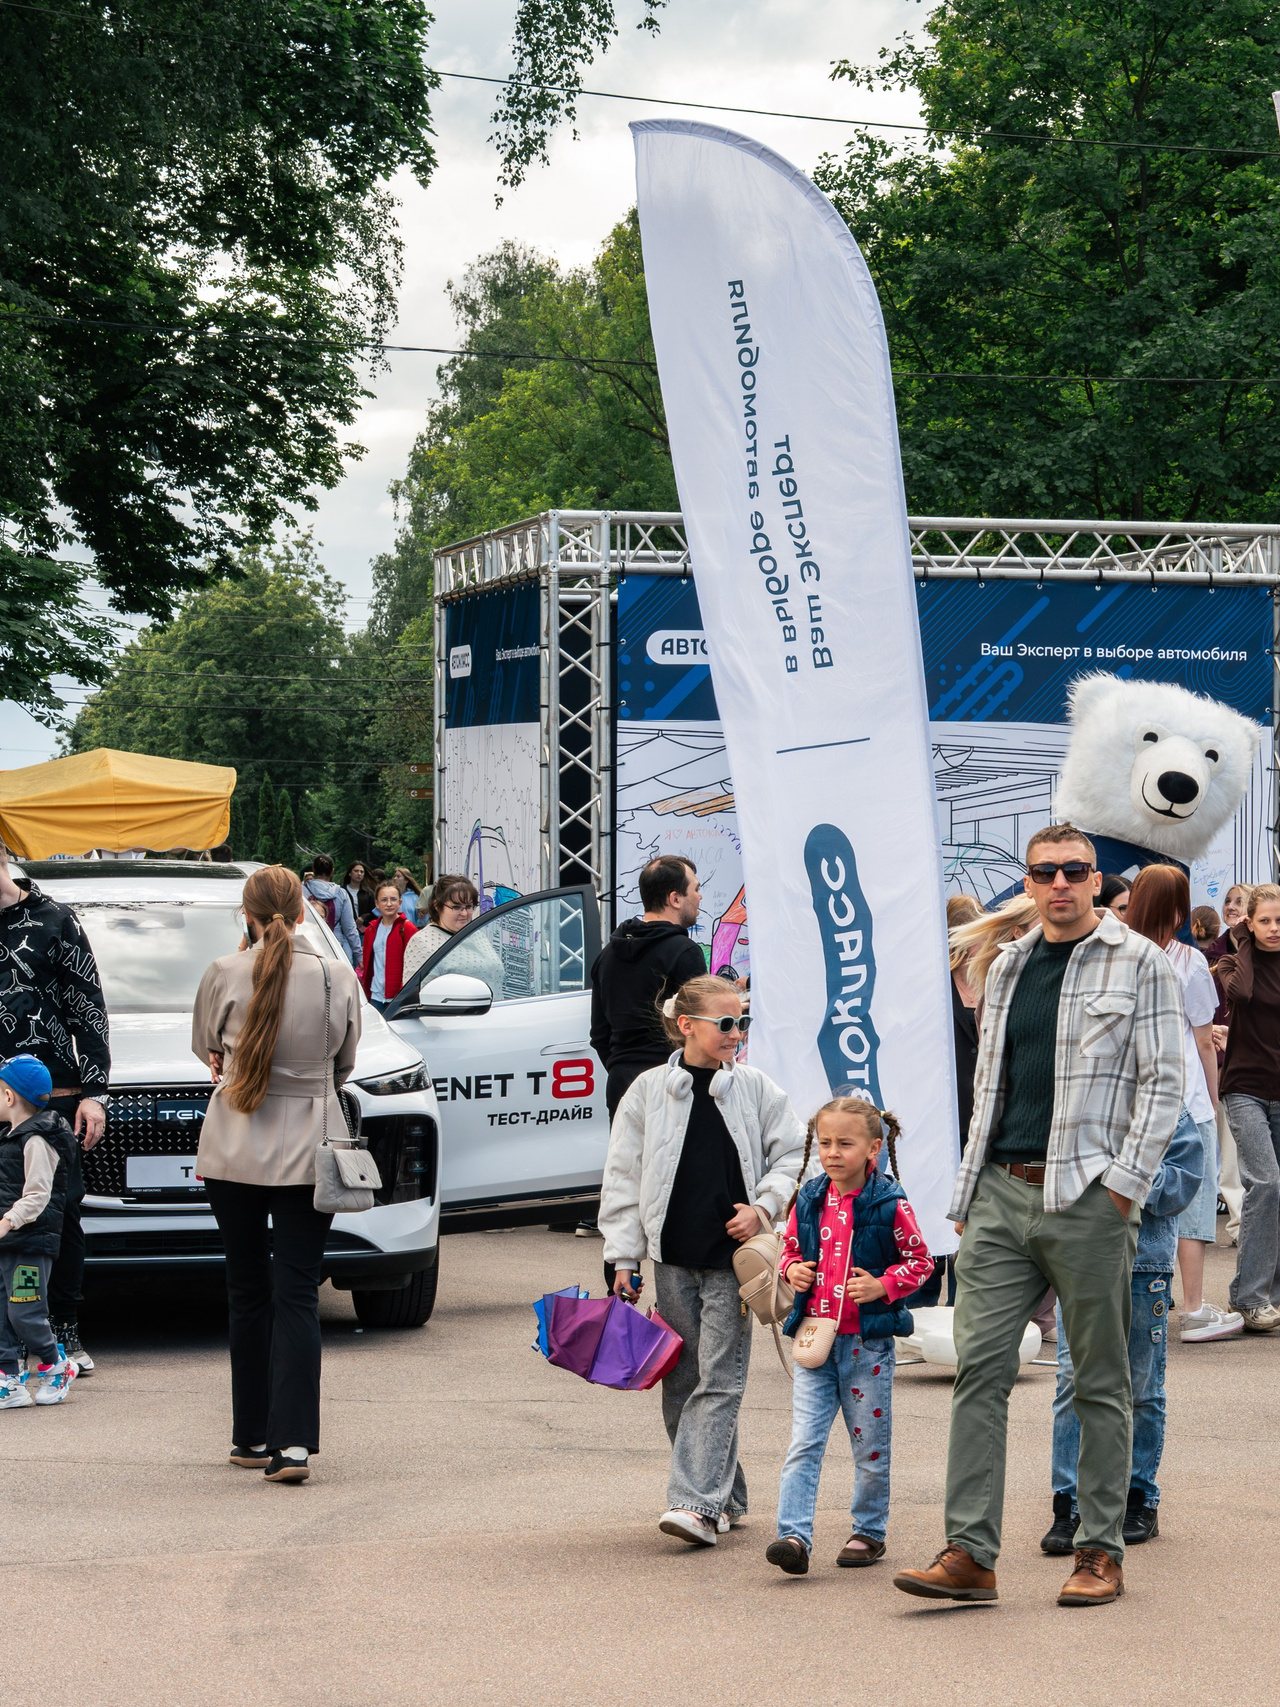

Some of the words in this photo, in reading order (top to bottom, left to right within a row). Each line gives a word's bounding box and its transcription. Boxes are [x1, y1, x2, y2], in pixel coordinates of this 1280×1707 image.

[980, 642, 1013, 657] Ваш
[1017, 643, 1081, 661] Эксперт
[1083, 647, 1093, 658] в
[1096, 644, 1154, 662] выборе
[1157, 646, 1247, 661] автомобиля
[432, 1072, 514, 1102] ENET
[526, 1058, 595, 1100] T8
[487, 1104, 594, 1127] ТЕСТ-ДРАЙВ
